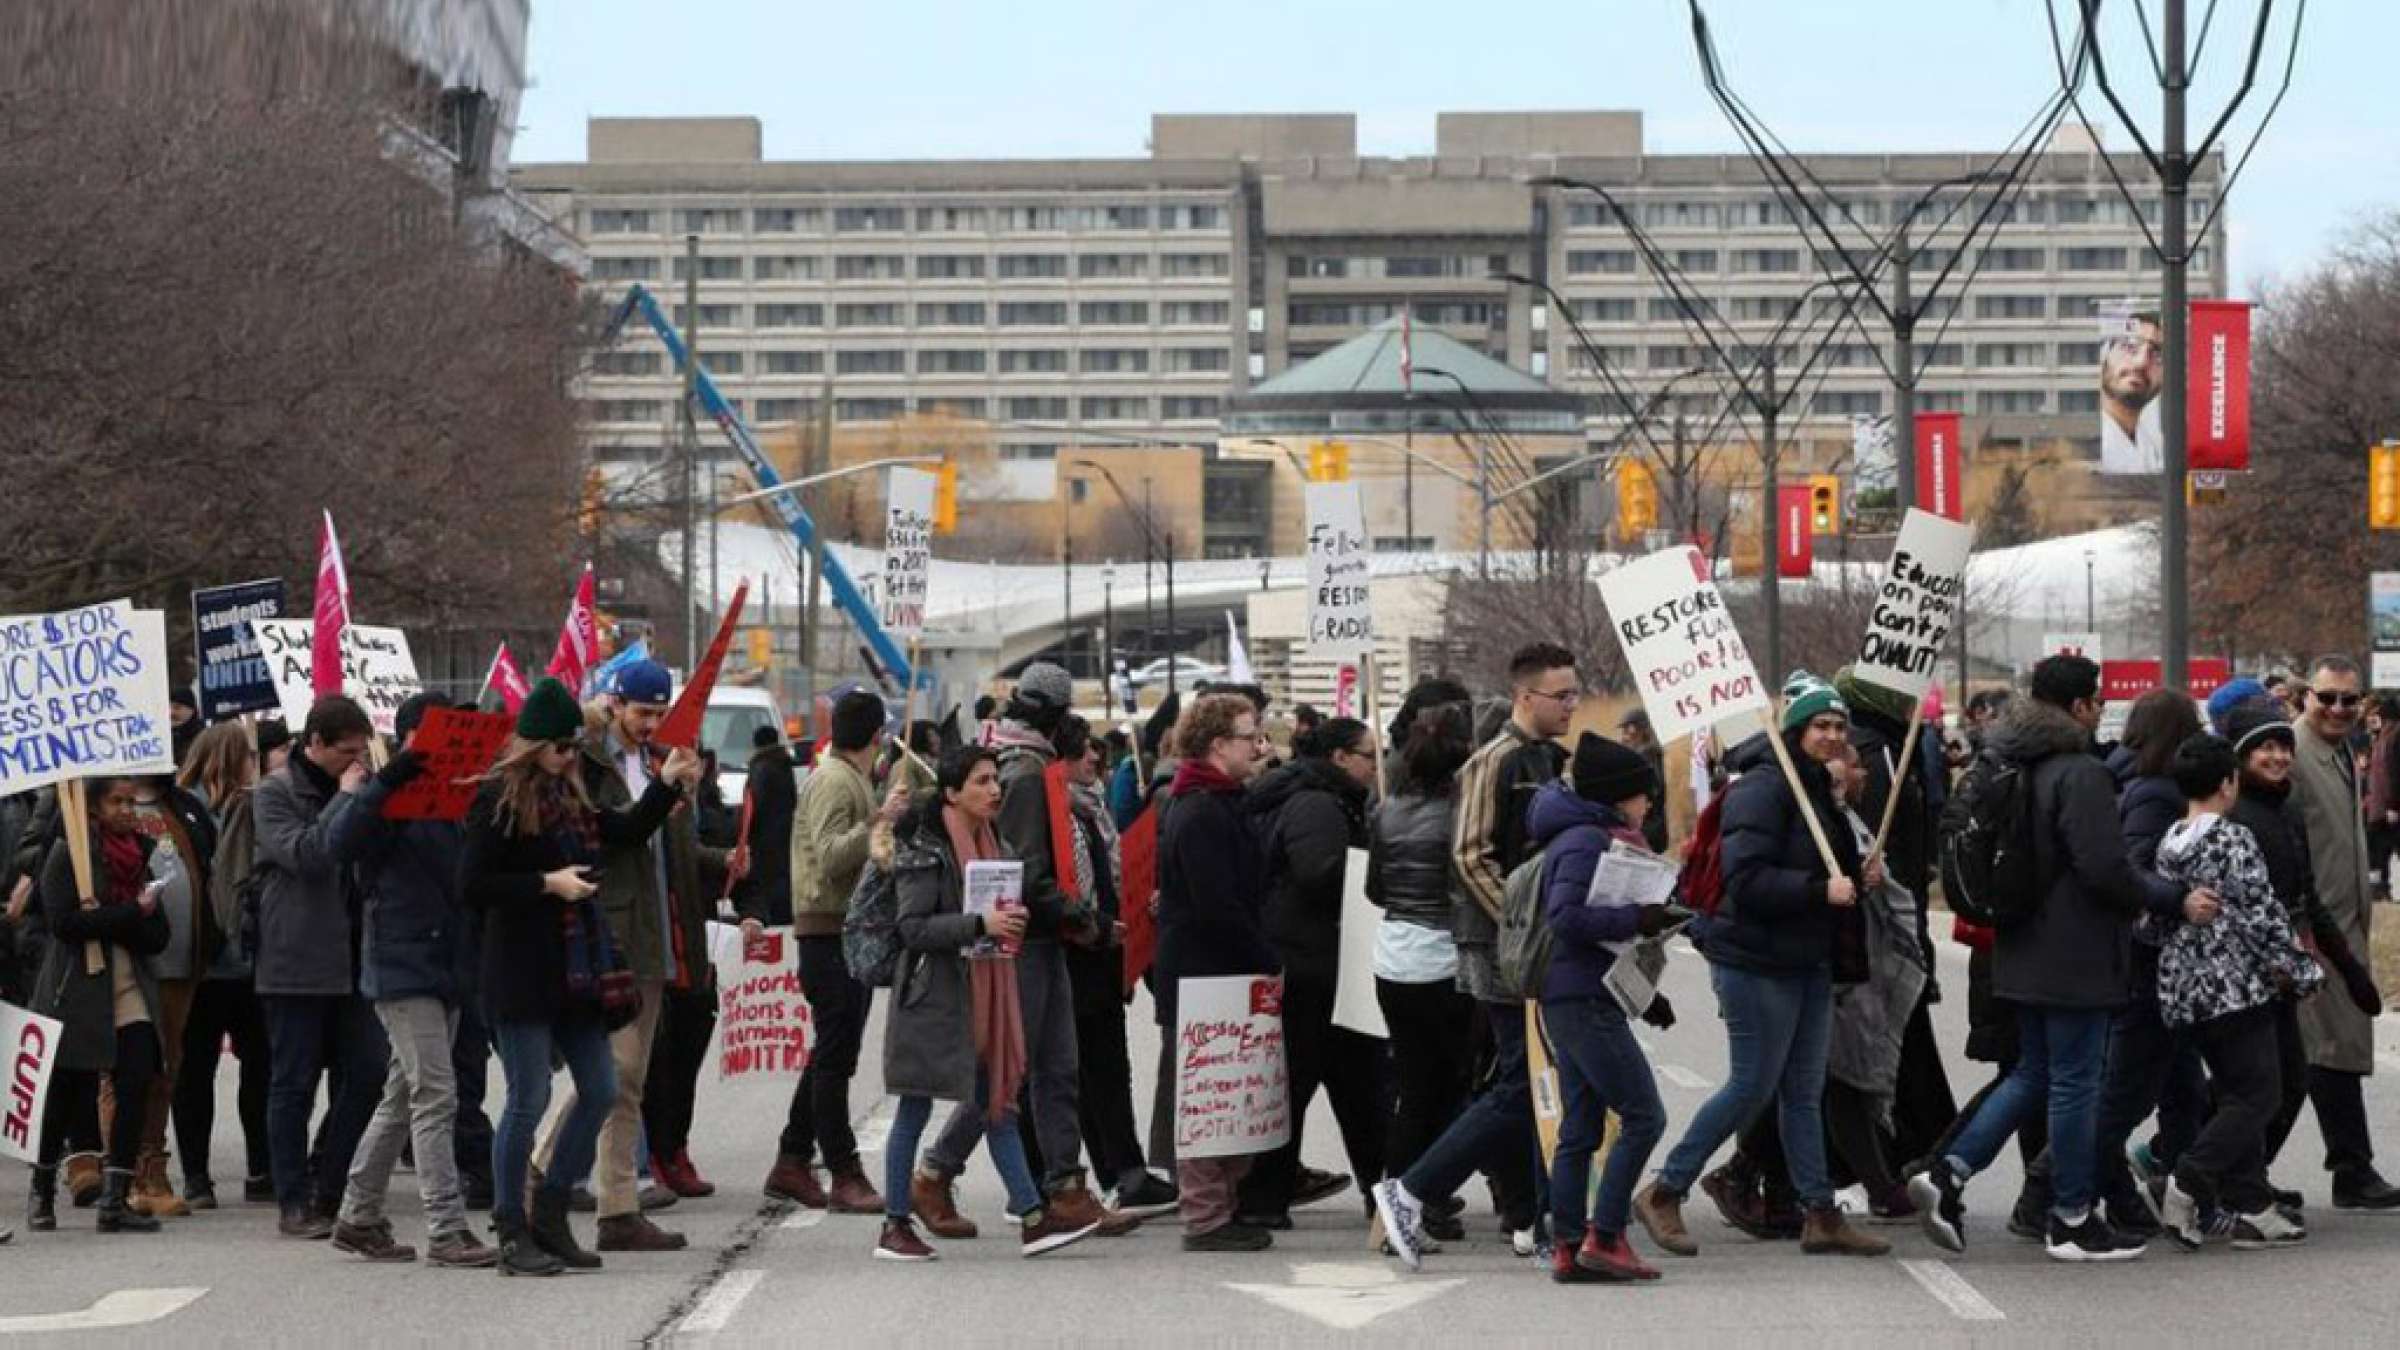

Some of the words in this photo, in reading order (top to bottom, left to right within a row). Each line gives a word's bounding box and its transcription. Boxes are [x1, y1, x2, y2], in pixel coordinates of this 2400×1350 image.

[1883, 582, 1913, 604] on
[66, 605, 119, 638] FOR
[1621, 590, 1720, 647] RESTORE
[72, 687, 126, 719] FOR
[1675, 694, 1702, 720] IS
[1710, 675, 1754, 707] NOT
[3, 1021, 46, 1150] CUPE
